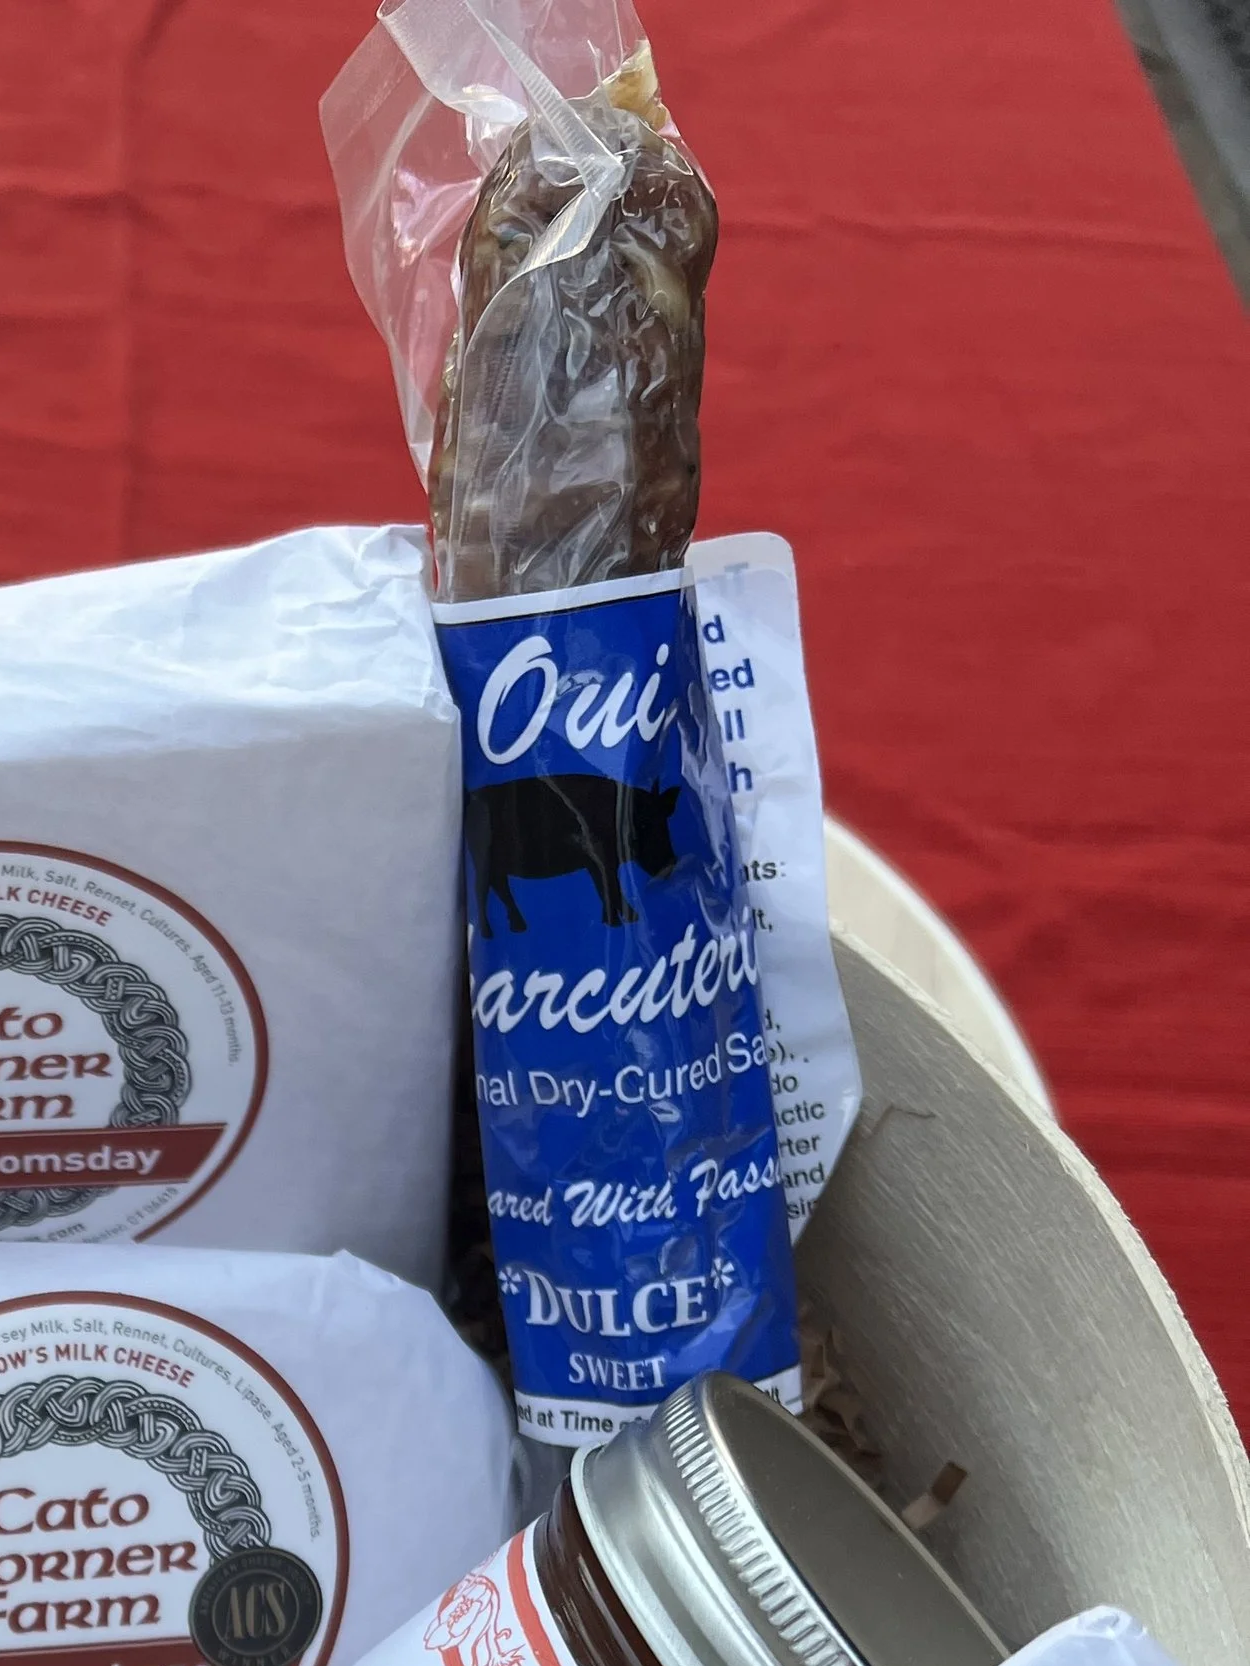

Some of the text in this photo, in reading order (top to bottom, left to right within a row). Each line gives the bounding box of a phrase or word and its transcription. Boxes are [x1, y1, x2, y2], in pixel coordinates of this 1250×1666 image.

[477, 635, 678, 765] Oui
[27, 889, 113, 927] CHEESE
[190, 955, 219, 985] Aged
[529, 1043, 721, 1118] Dry-Cured
[563, 1171, 678, 1228] With
[30, 1319, 69, 1336] Milk,
[72, 1318, 108, 1335] Salt,
[271, 1422, 300, 1457] Aged
[54, 1342, 108, 1363] MILK
[113, 1345, 196, 1389] CHEESE
[568, 1352, 666, 1392] SWEET
[537, 1411, 554, 1428] at
[561, 1410, 613, 1433] Time
[223, 1581, 287, 1641] ACS
